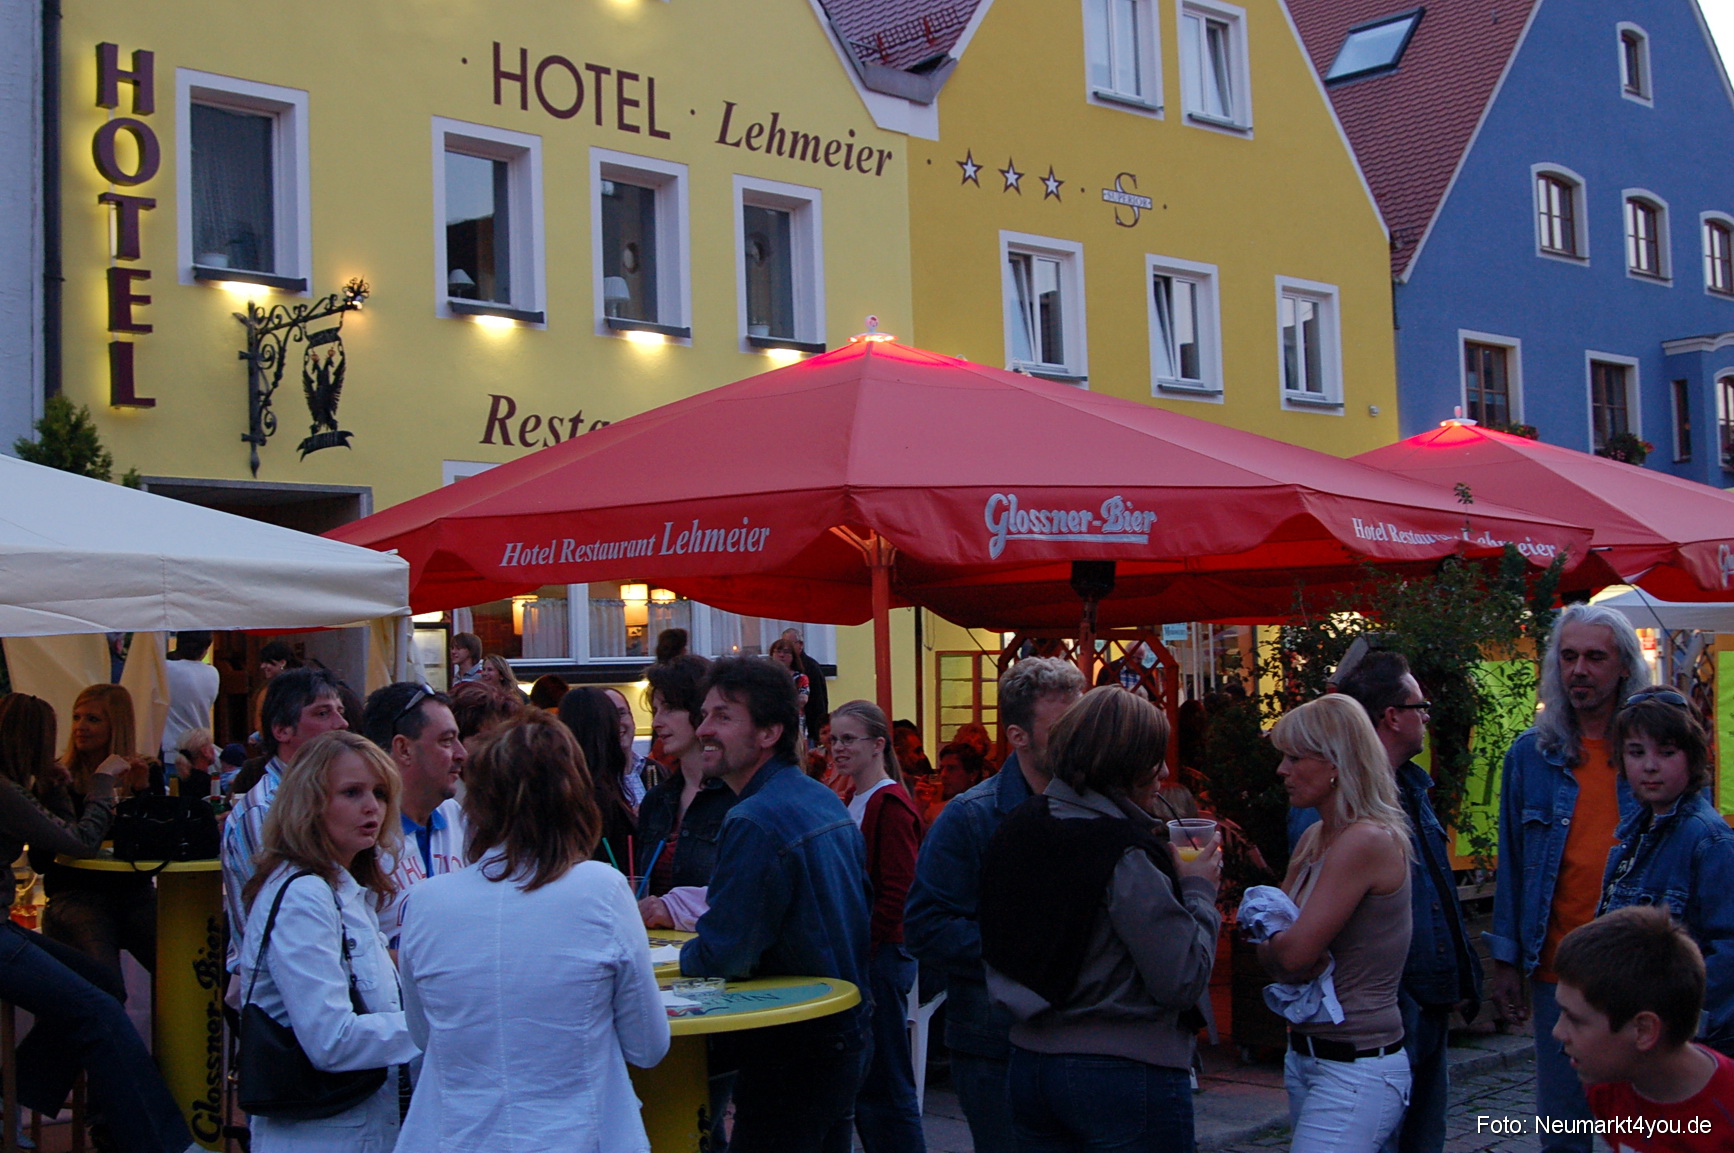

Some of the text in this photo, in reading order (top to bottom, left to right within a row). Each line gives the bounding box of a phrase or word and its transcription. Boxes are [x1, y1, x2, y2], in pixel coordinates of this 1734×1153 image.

[492, 41, 892, 177] HOTEL Lehmeier
[92, 41, 160, 409] HOTEL
[499, 516, 770, 567] Hotel Restaurant Lehmeier
[984, 492, 1157, 560] Glossner-Bier
[1352, 517, 1389, 542] Hotel
